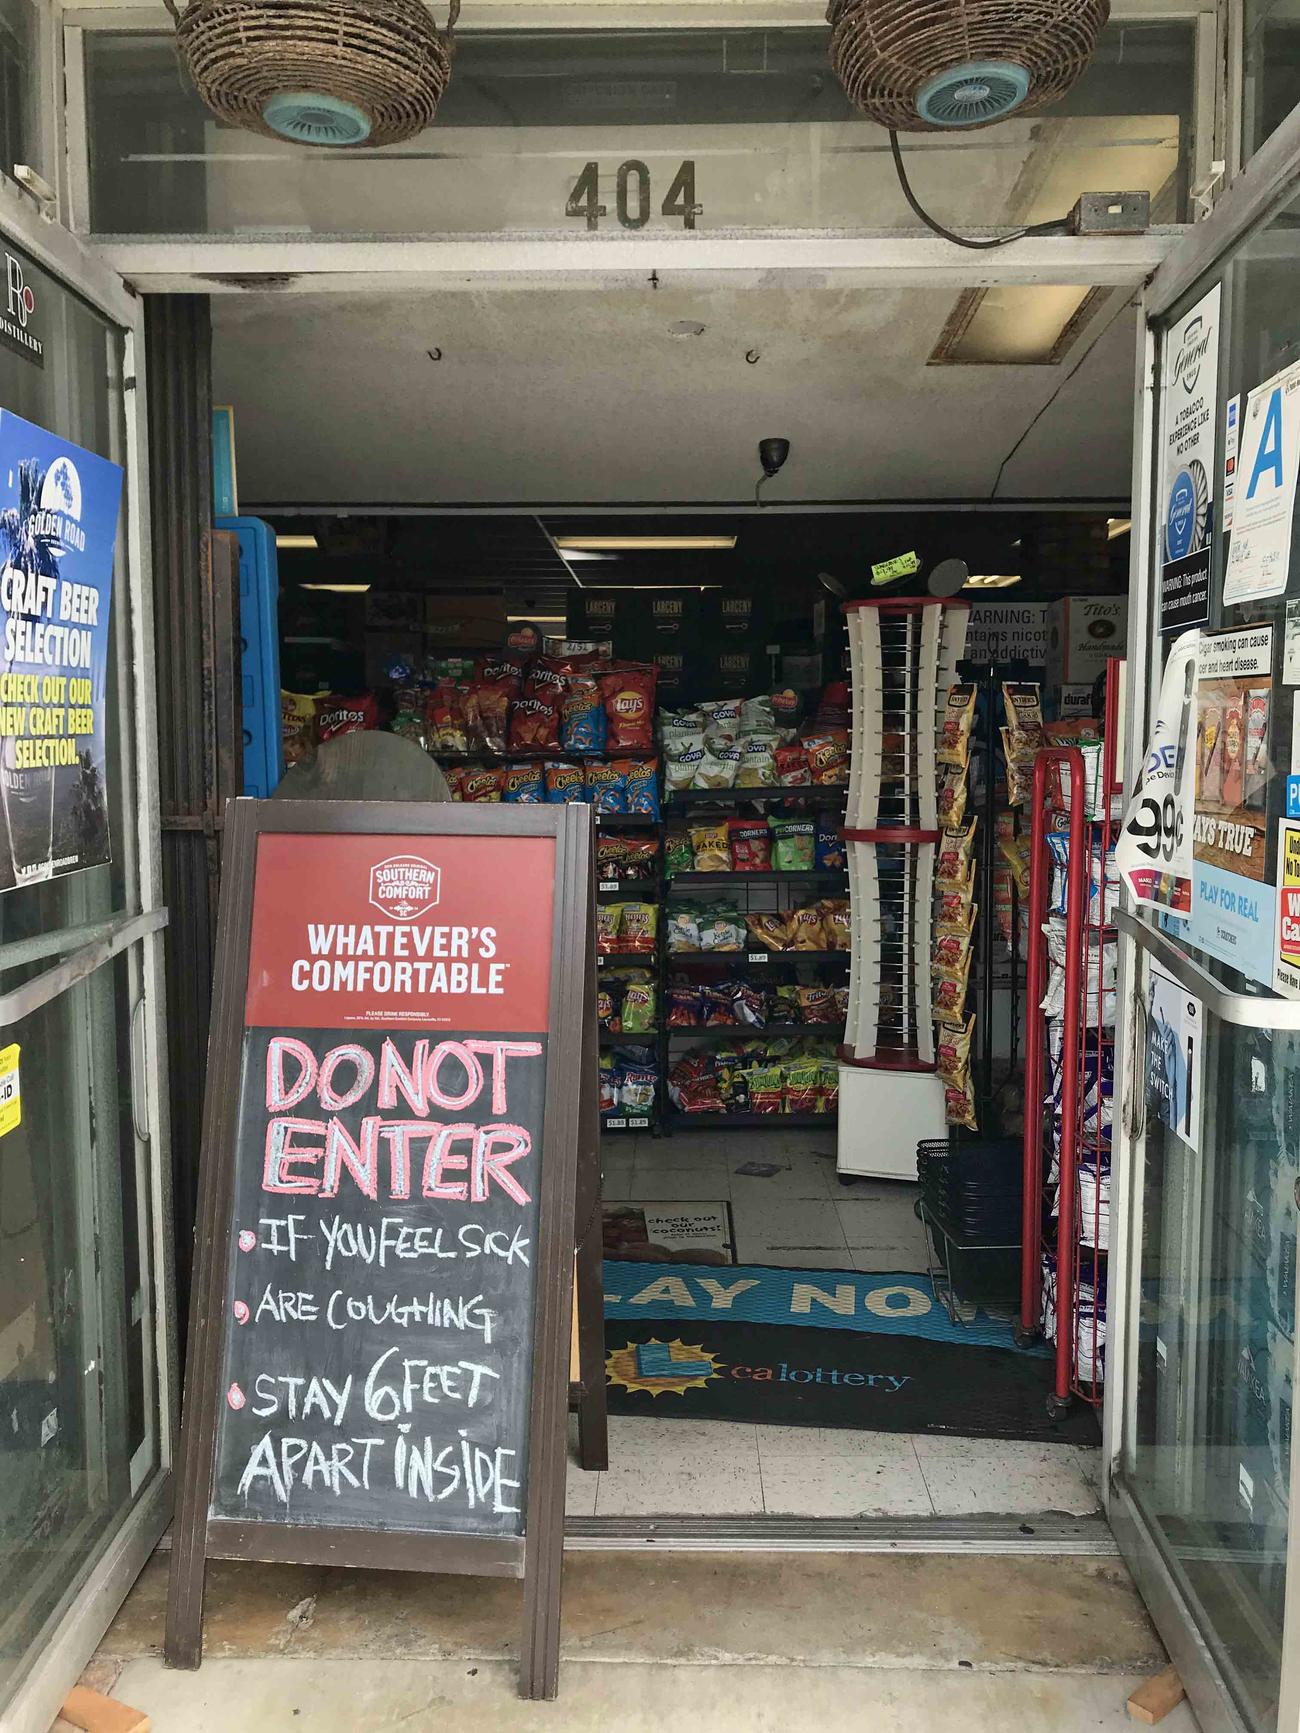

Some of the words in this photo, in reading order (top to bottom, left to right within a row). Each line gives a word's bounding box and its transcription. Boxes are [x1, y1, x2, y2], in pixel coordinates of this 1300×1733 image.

[565, 160, 703, 231] 404
[1175, 414, 1179, 425] A
[1180, 396, 1204, 422] TOBACCO
[1169, 417, 1197, 446] EXPERIENCE
[1198, 408, 1209, 427] LIKE
[1177, 443, 1183, 456] NO
[1185, 432, 1200, 451] OTHER
[1245, 386, 1283, 500] A
[29, 512, 62, 539] GOLDEN
[65, 519, 86, 552] ROAD
[1161, 575, 1182, 593] WARNING:
[1183, 572, 1191, 586] This
[1191, 568, 1208, 587] product
[1, 566, 57, 619] CRAFT
[60, 580, 100, 627] BEER
[585, 600, 616, 614] LARCENY
[653, 600, 683, 613] LARCENY
[721, 599, 752, 613] LARCENY
[1168, 598, 1180, 611] cause
[1180, 592, 1192, 607] mouth
[1083, 603, 1121, 616] Tito's
[4, 617, 92, 669] SELECTION
[1213, 637, 1236, 654] smoking
[1238, 637, 1249, 649] can
[1250, 634, 1269, 648] cause
[484, 663, 522, 677] Doritos
[1208, 660, 1218, 673] and
[1219, 659, 1233, 672] heart
[1235, 656, 1259, 671] disease.
[1, 672, 39, 703] CHECK
[42, 674, 67, 704] OUT
[69, 677, 92, 705] OUR
[615, 697, 643, 713] Lay's
[712, 709, 736, 720] GOYA
[29, 706, 65, 736] CRAFT
[68, 707, 94, 735] BEER
[320, 710, 364, 727] Doritos
[15, 738, 80, 770] SELECTION.
[679, 751, 704, 763] GOYA
[719, 751, 741, 761] GOYA
[747, 745, 767, 753] OYA
[816, 743, 848, 768] Cheetos
[509, 770, 541, 791] Cheetos
[556, 771, 586, 789] Cheetos
[586, 768, 623, 786] Cheetos
[1193, 814, 1216, 846] AYS
[1218, 820, 1255, 857] TRUE
[376, 868, 435, 883] SOUTHERN
[1286, 857, 1293, 875] No
[378, 886, 432, 899] COMFORT
[1200, 880, 1217, 906] PLAY
[1220, 886, 1236, 912] FOR
[1238, 892, 1259, 922] REAL
[308, 924, 497, 959] WHATEVER'S
[1277, 968, 1289, 984] Please
[1151, 1031, 1168, 1055] MAKE
[1151, 1051, 1161, 1071] THE
[266, 1036, 375, 1112] DO
[377, 1036, 543, 1117] NOT
[1150, 1071, 1173, 1101] SWITCH
[262, 1115, 532, 1207] ENTER
[648, 1216, 689, 1224] check
[652, 1224, 721, 1234] coconuts!
[259, 1214, 316, 1261] IF
[319, 1214, 376, 1271] YOU
[379, 1216, 457, 1268] FEEL
[255, 1282, 320, 1324] ARE
[326, 1289, 499, 1344] COUGHING
[252, 1373, 352, 1426] STAY
[364, 1346, 401, 1422] 6
[402, 1358, 500, 1414] FEET
[237, 1430, 385, 1503] APART
